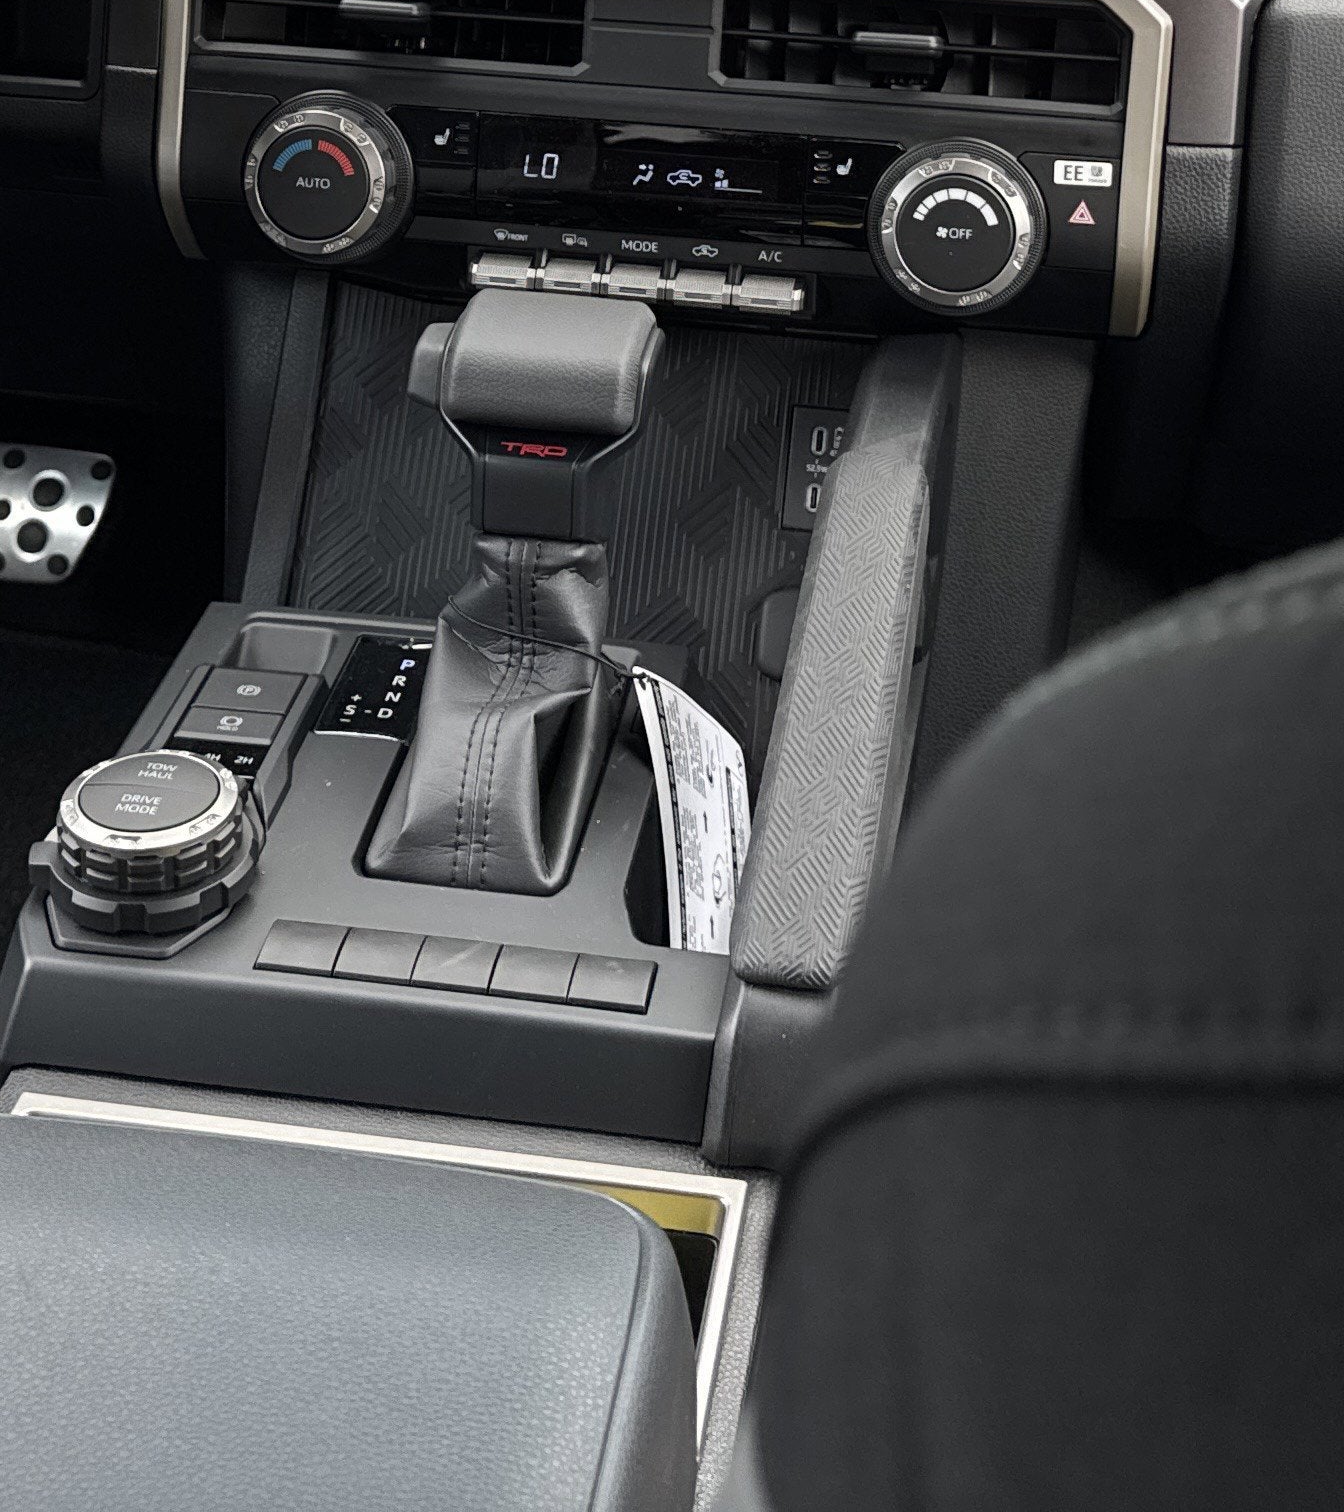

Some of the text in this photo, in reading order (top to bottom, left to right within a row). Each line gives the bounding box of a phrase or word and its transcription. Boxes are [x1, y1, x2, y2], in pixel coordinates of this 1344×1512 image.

[1063, 164, 1084, 181] EE
[295, 176, 330, 190] AUTO
[507, 232, 529, 241] FRONT
[948, 228, 973, 241] OFF
[621, 240, 659, 254] MODE
[758, 249, 783, 264] A/C
[500, 441, 568, 458] TRD
[399, 659, 416, 670] P
[392, 675, 407, 687] R
[384, 691, 402, 702] N
[343, 704, 357, 715] S
[376, 707, 393, 719] D
[234, 755, 254, 765] 2H
[146, 762, 178, 772] TOW
[137, 770, 175, 780] HAUL
[121, 793, 162, 805] DRIVE
[114, 804, 158, 815] MODE
